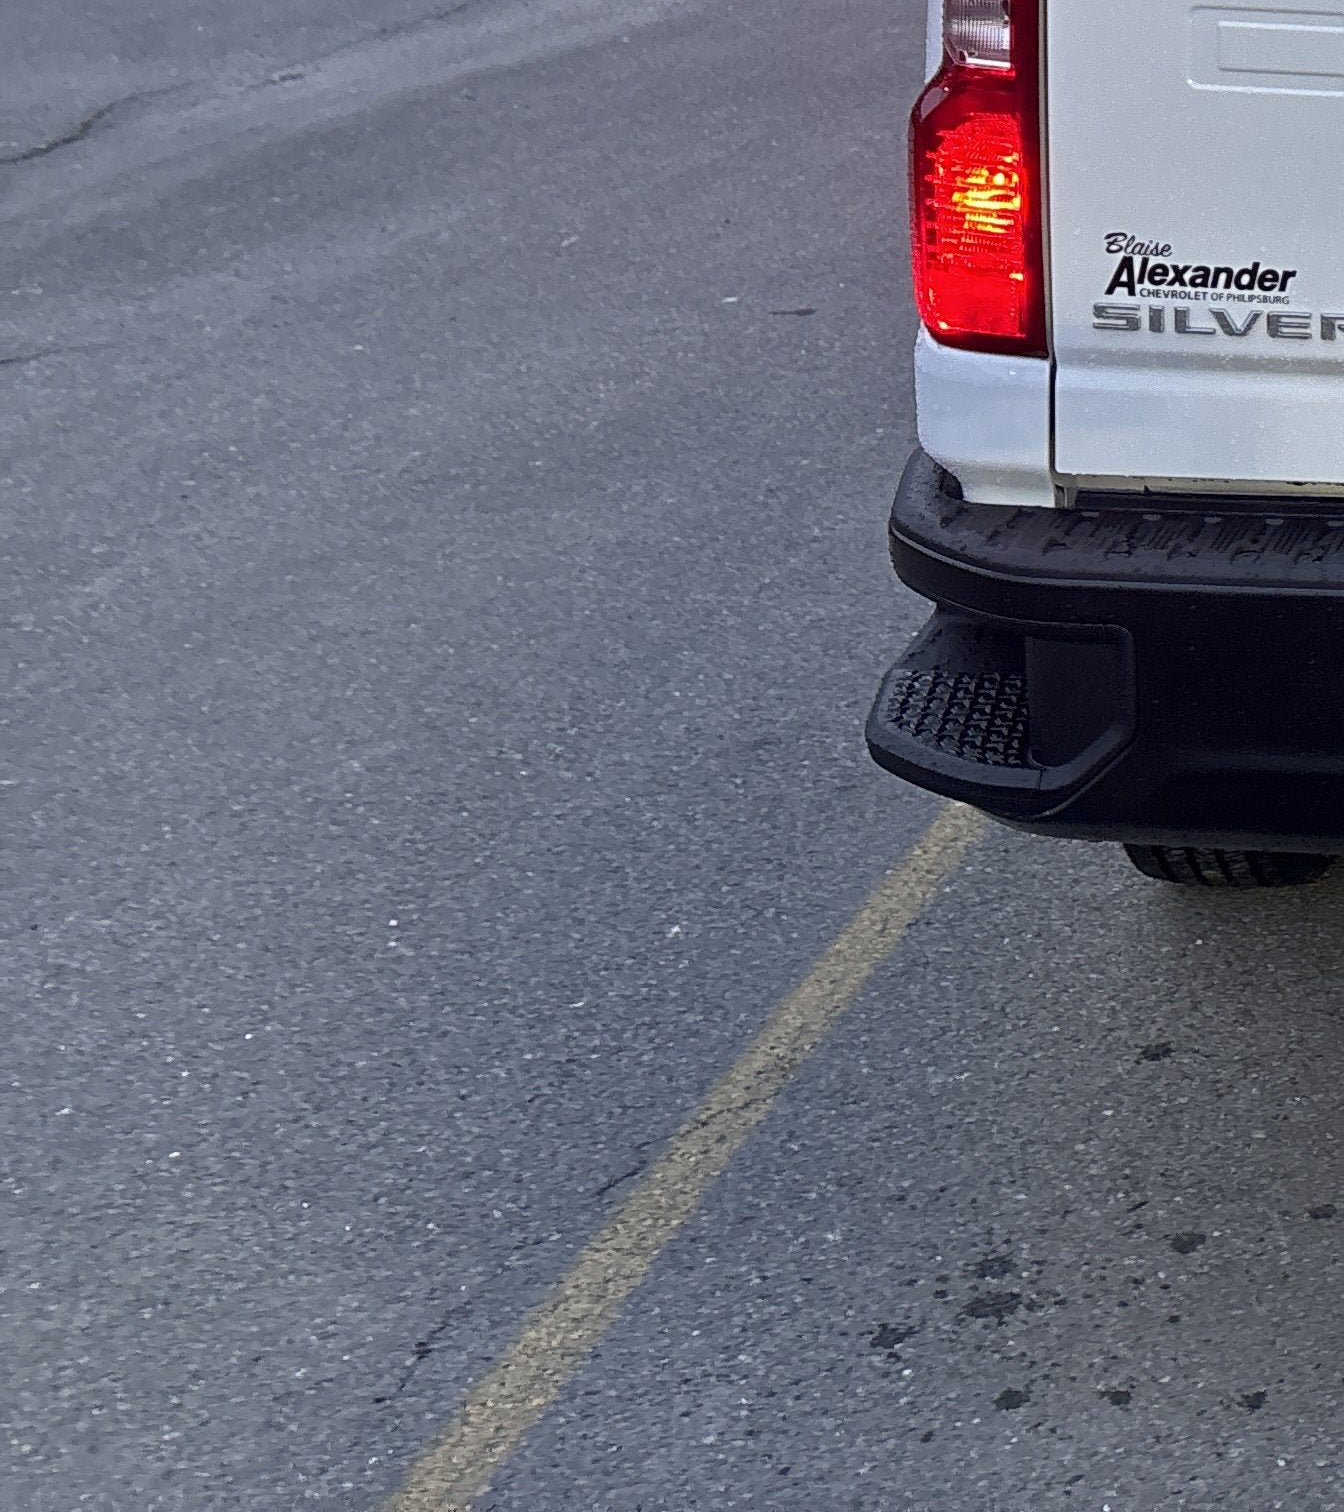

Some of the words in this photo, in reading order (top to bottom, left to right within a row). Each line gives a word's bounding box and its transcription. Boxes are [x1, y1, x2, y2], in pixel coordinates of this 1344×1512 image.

[1104, 232, 1172, 257] Blaise
[1105, 256, 1297, 296] Alexander
[1139, 287, 1209, 301] CHEVROLET
[1210, 292, 1224, 302] OF
[1225, 293, 1290, 305] PHILIPSBURG
